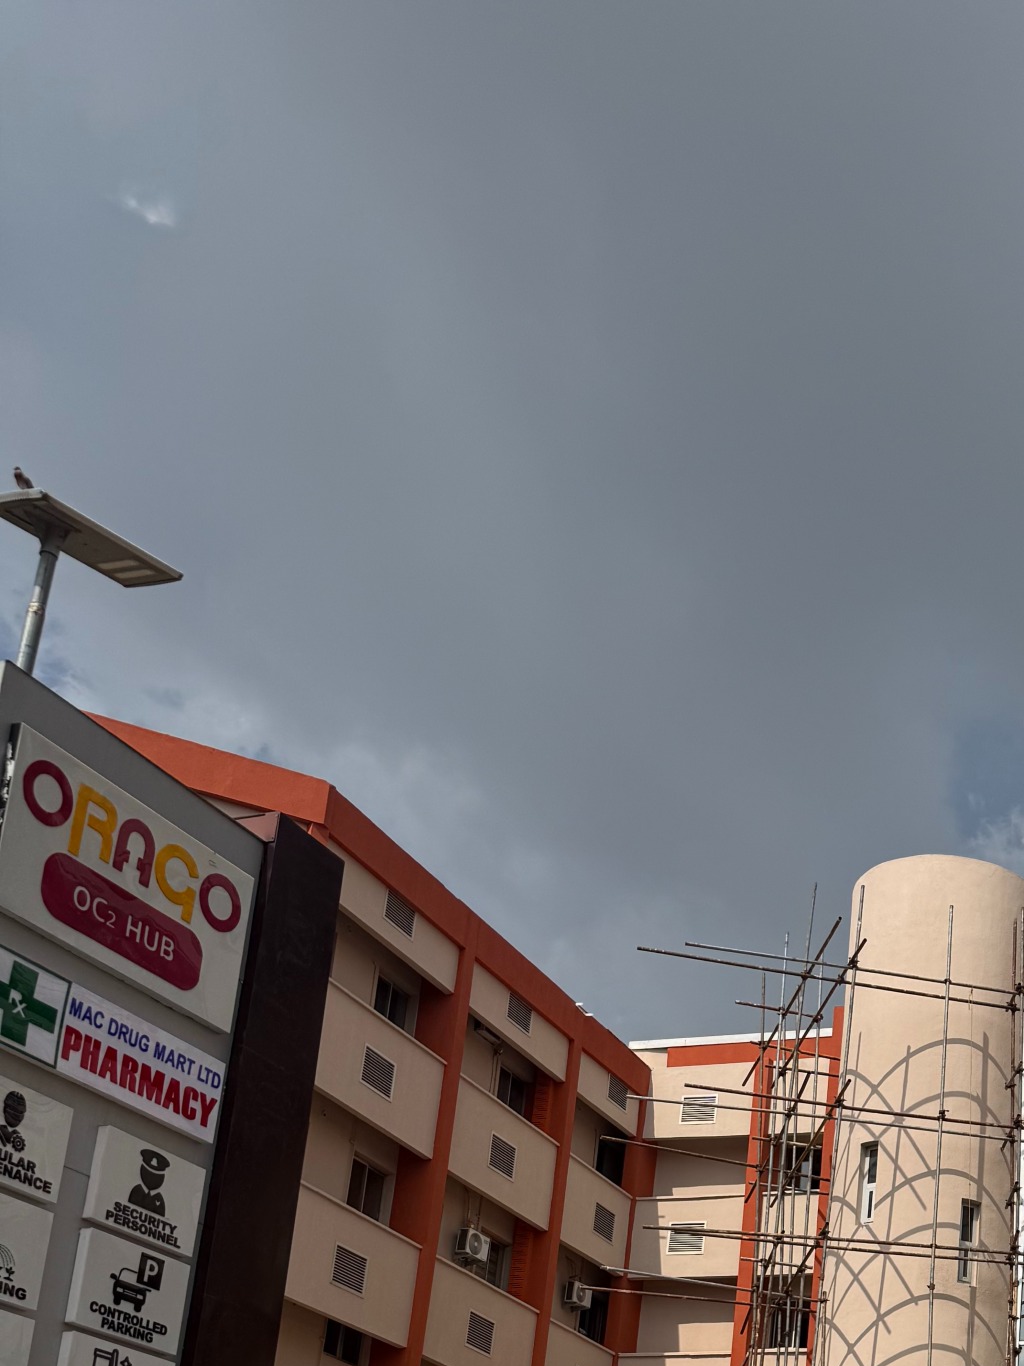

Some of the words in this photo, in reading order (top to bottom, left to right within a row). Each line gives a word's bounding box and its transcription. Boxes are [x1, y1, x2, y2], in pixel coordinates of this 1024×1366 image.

[23, 760, 241, 932] ORAGO
[73, 885, 116, 928] OC2
[125, 915, 175, 961] HUB
[69, 997, 105, 1029] MAC
[108, 1018, 150, 1052] DRUG
[153, 1041, 195, 1075] MART
[197, 1064, 221, 1089] LTD
[61, 1025, 217, 1127] PHARMACY
[105, 1209, 181, 1249] PERSONNEL
[113, 1202, 177, 1235] SECURITY
[90, 1301, 168, 1336] CONTROLLED
[101, 1317, 153, 1343] PARKING
